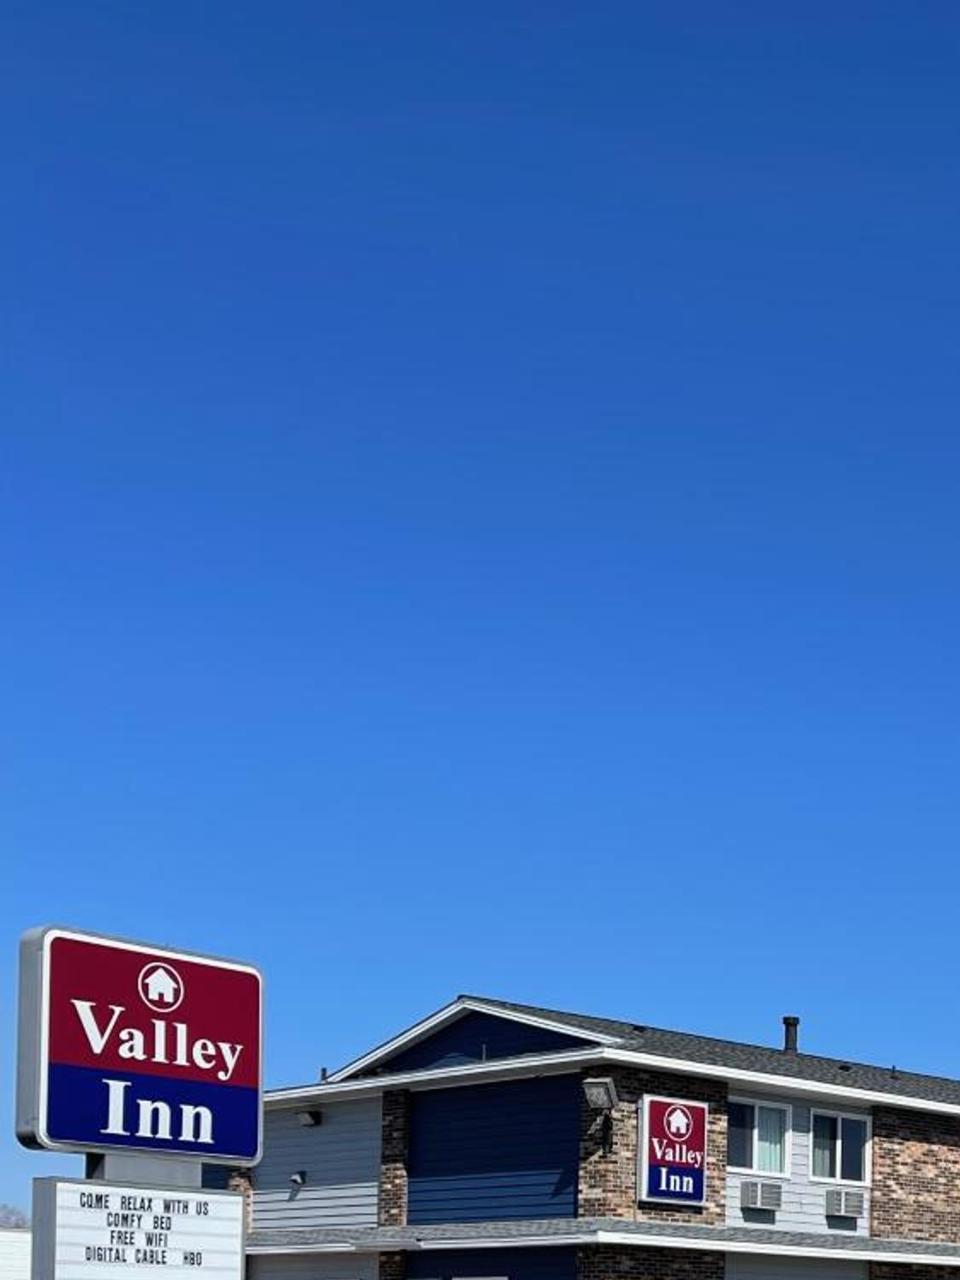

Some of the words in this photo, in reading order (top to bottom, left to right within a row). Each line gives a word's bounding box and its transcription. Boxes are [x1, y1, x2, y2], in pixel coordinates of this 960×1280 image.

[70, 998, 245, 1082] Valley
[100, 1078, 215, 1144] Inn
[651, 1138, 703, 1168] Valley
[659, 1167, 693, 1193] Inn
[79, 1192, 109, 1209] COME
[120, 1195, 153, 1212] RELAX
[163, 1199, 189, 1215] WITH
[195, 1200, 210, 1216] US
[106, 1212, 143, 1229] COMFY
[153, 1215, 172, 1231] BED
[110, 1229, 135, 1246] FREE
[145, 1231, 168, 1247] WIFI
[84, 1246, 127, 1264] DIGITAL
[134, 1249, 168, 1265] CABLE
